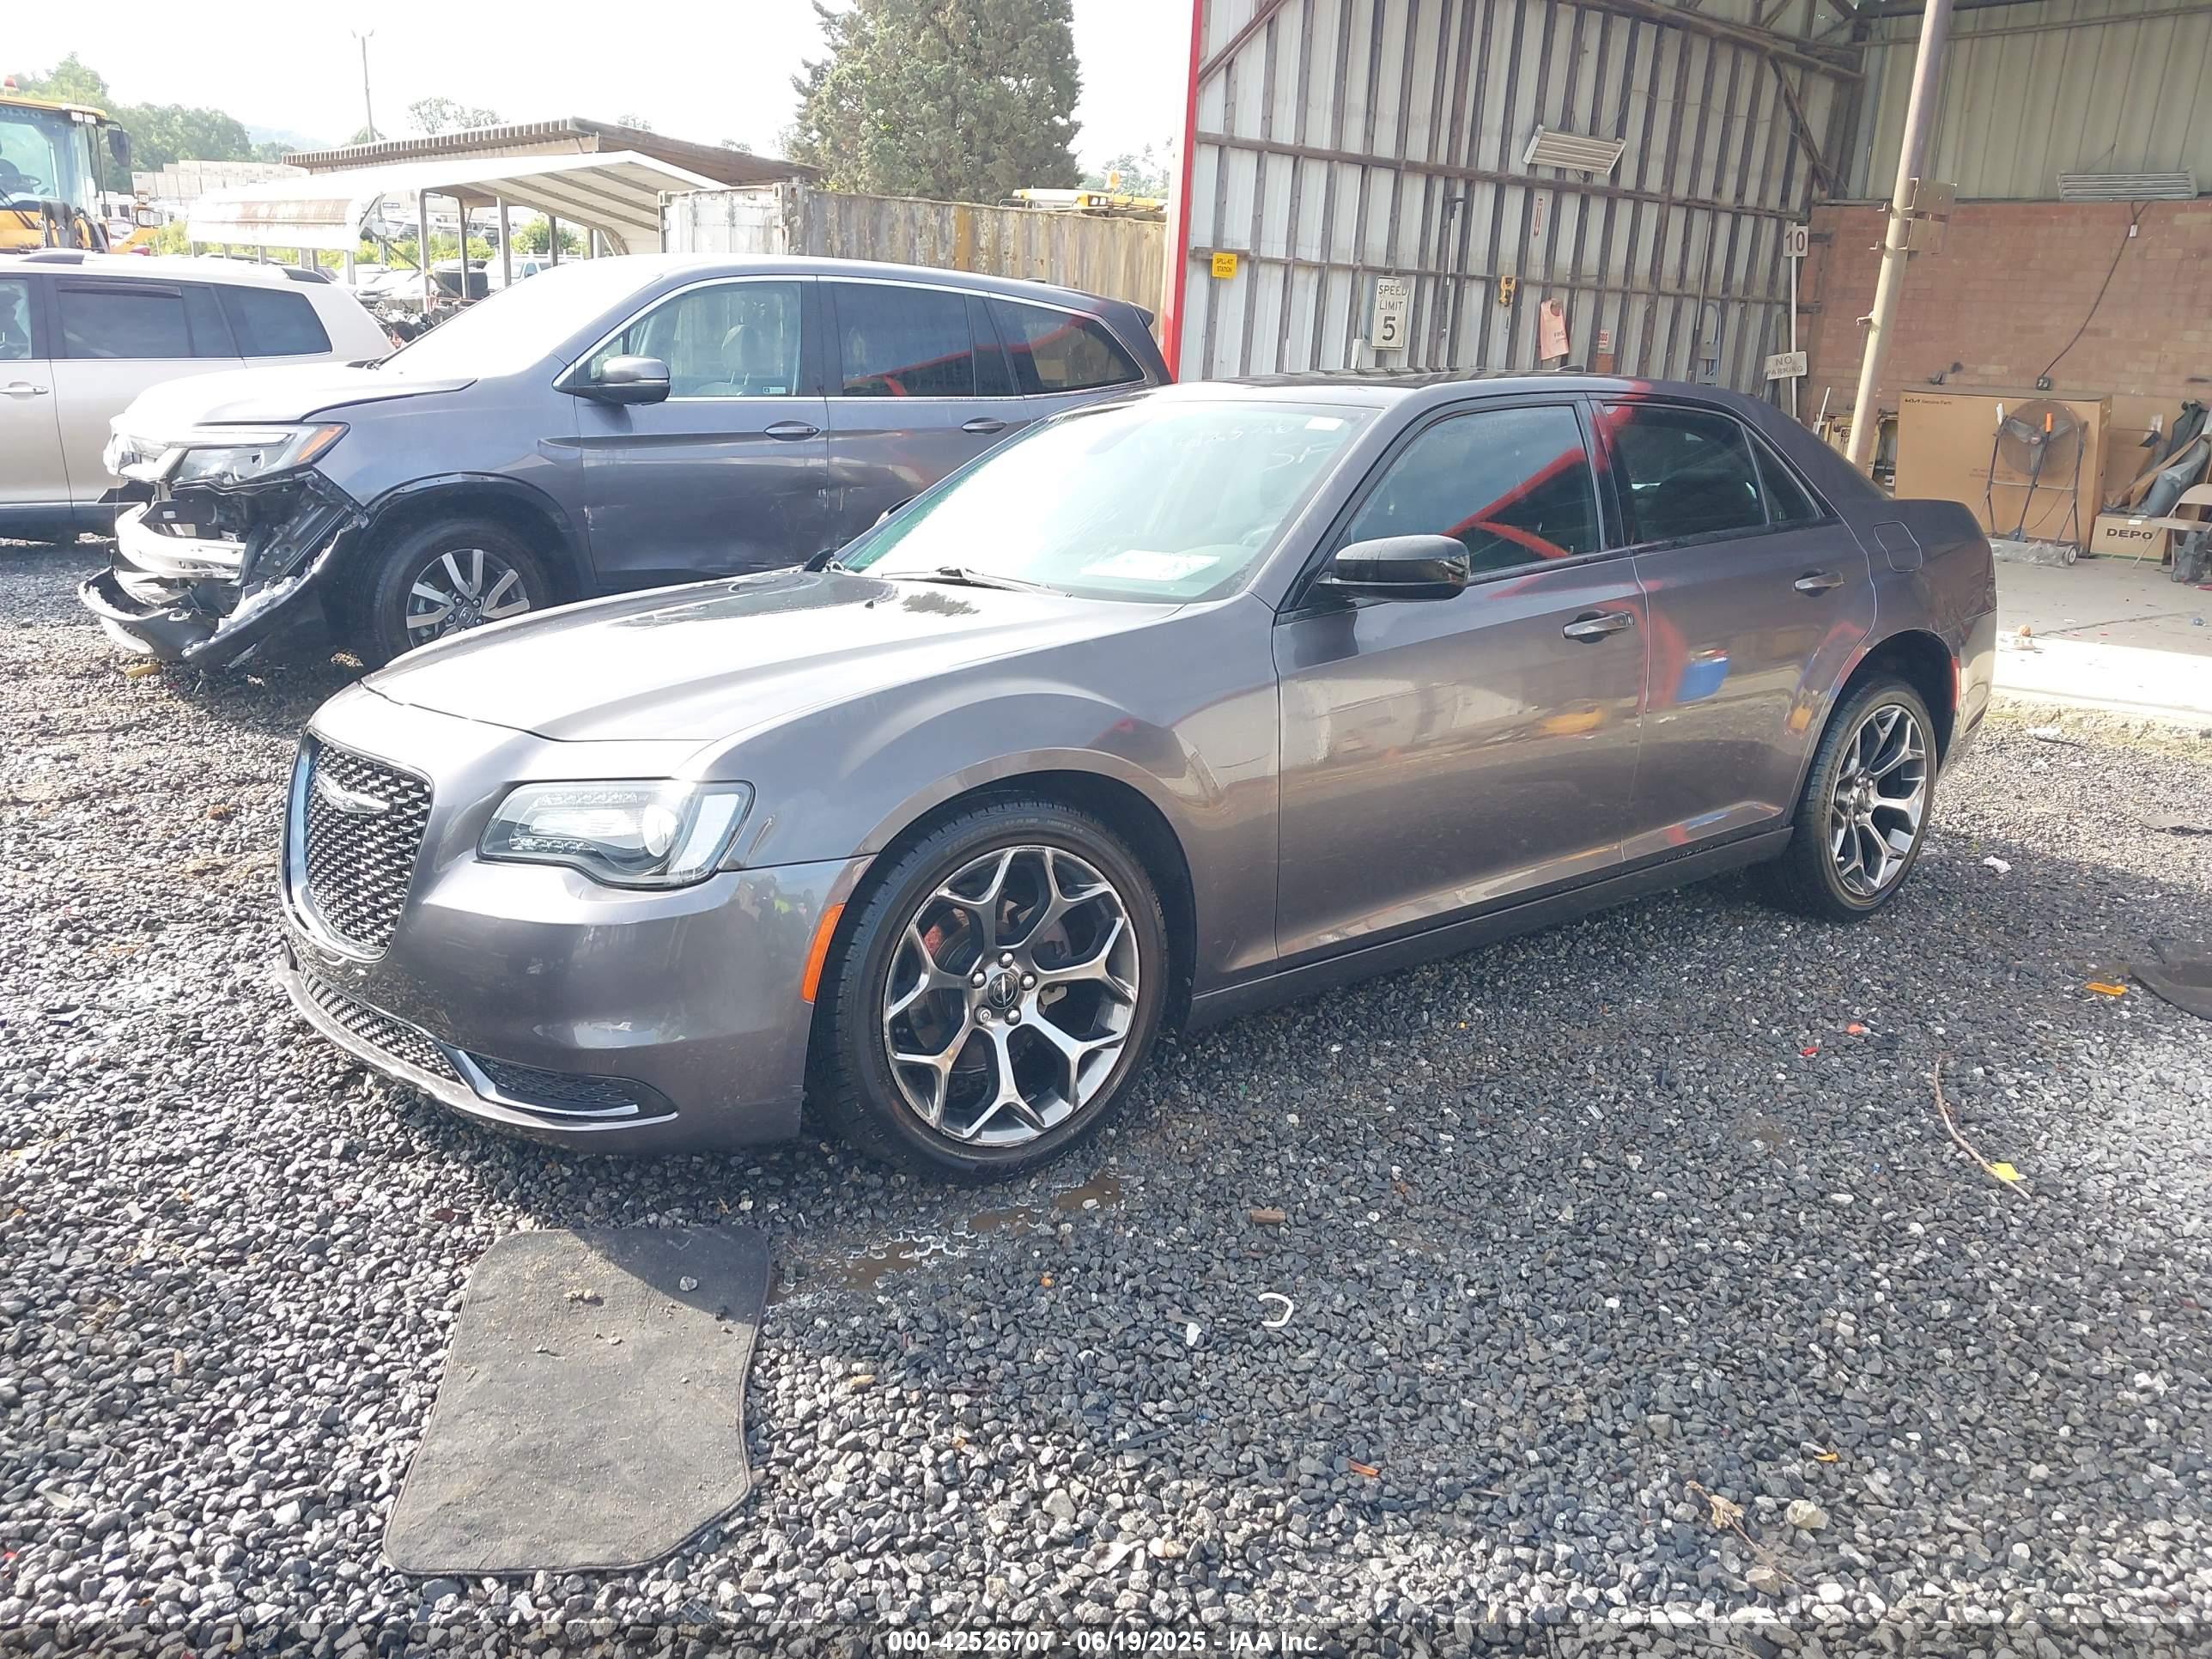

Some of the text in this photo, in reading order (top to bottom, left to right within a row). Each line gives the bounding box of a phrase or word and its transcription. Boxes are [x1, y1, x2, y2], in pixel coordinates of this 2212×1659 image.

[1785, 230, 1805, 252] 10
[1378, 284, 1410, 296] SPEED
[1379, 301, 1403, 312] LIMIT
[1382, 315, 1396, 341] 5
[1776, 356, 1792, 366] NO
[1766, 365, 1803, 376] PARKING
[2106, 528, 2153, 539] DEPO
